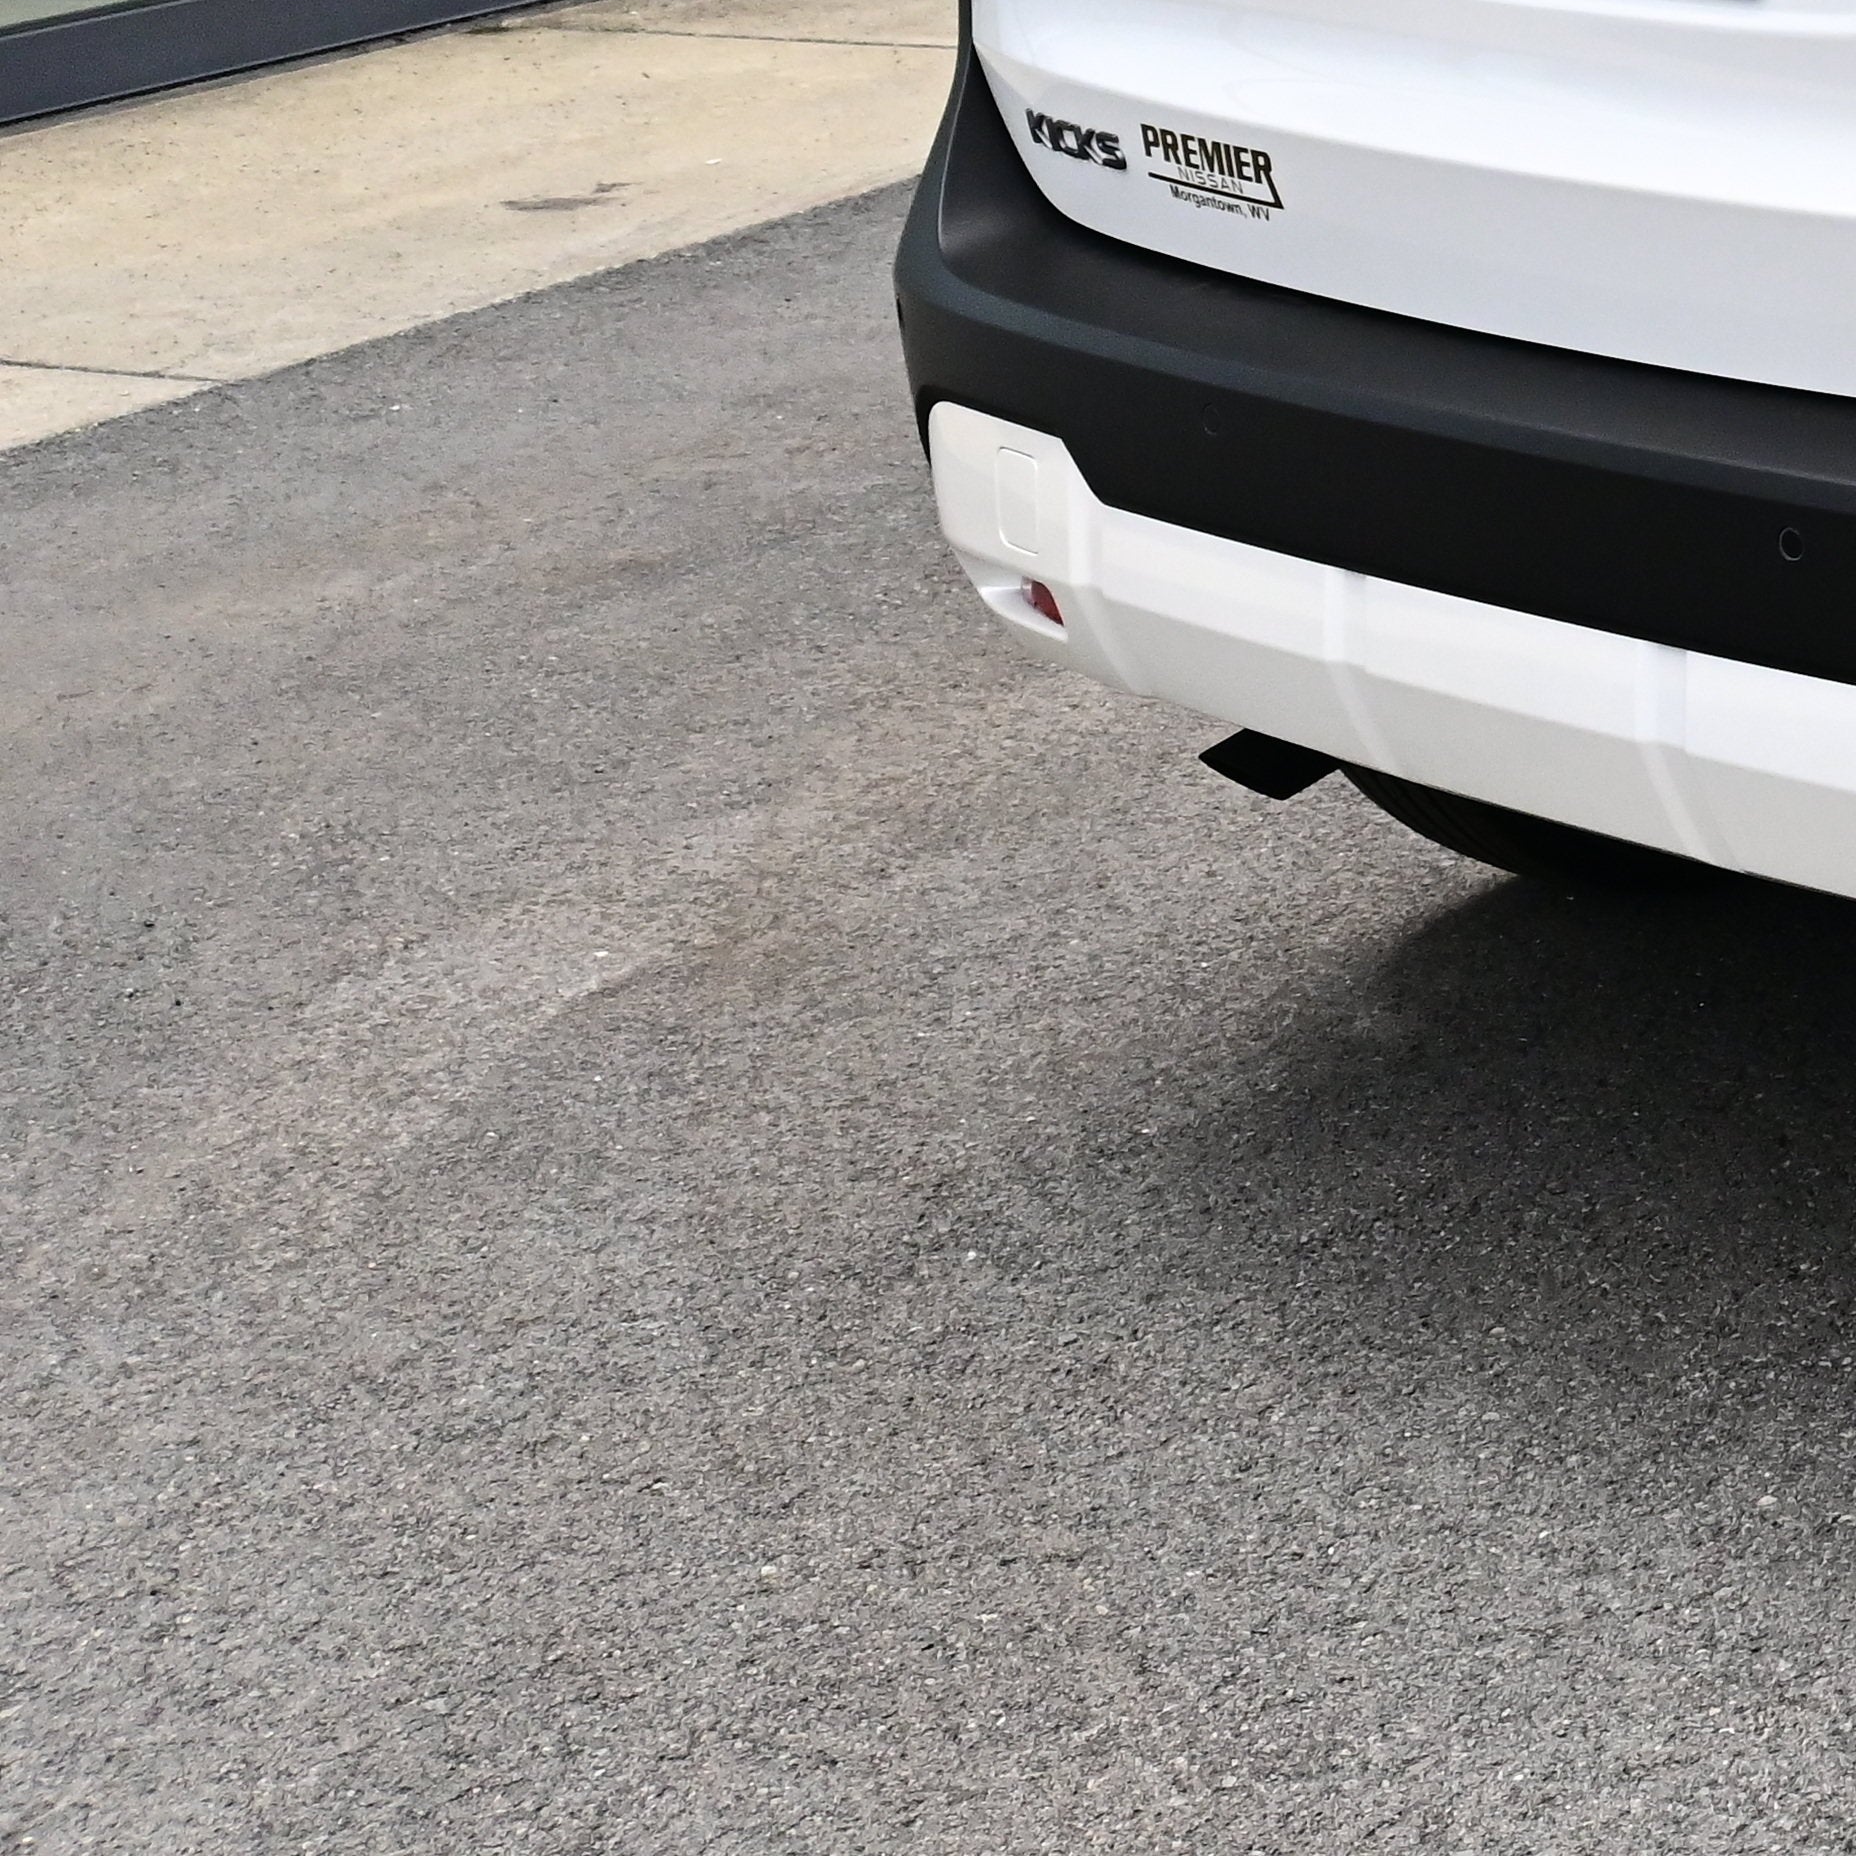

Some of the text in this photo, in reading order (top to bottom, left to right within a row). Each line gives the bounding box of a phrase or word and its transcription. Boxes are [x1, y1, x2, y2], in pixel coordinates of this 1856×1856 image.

[1025, 108, 1127, 170] KICKS
[1140, 123, 1273, 185] PREMIER
[1169, 184, 1271, 222] Morgantown, WV
[1176, 165, 1244, 195] NISSAN
